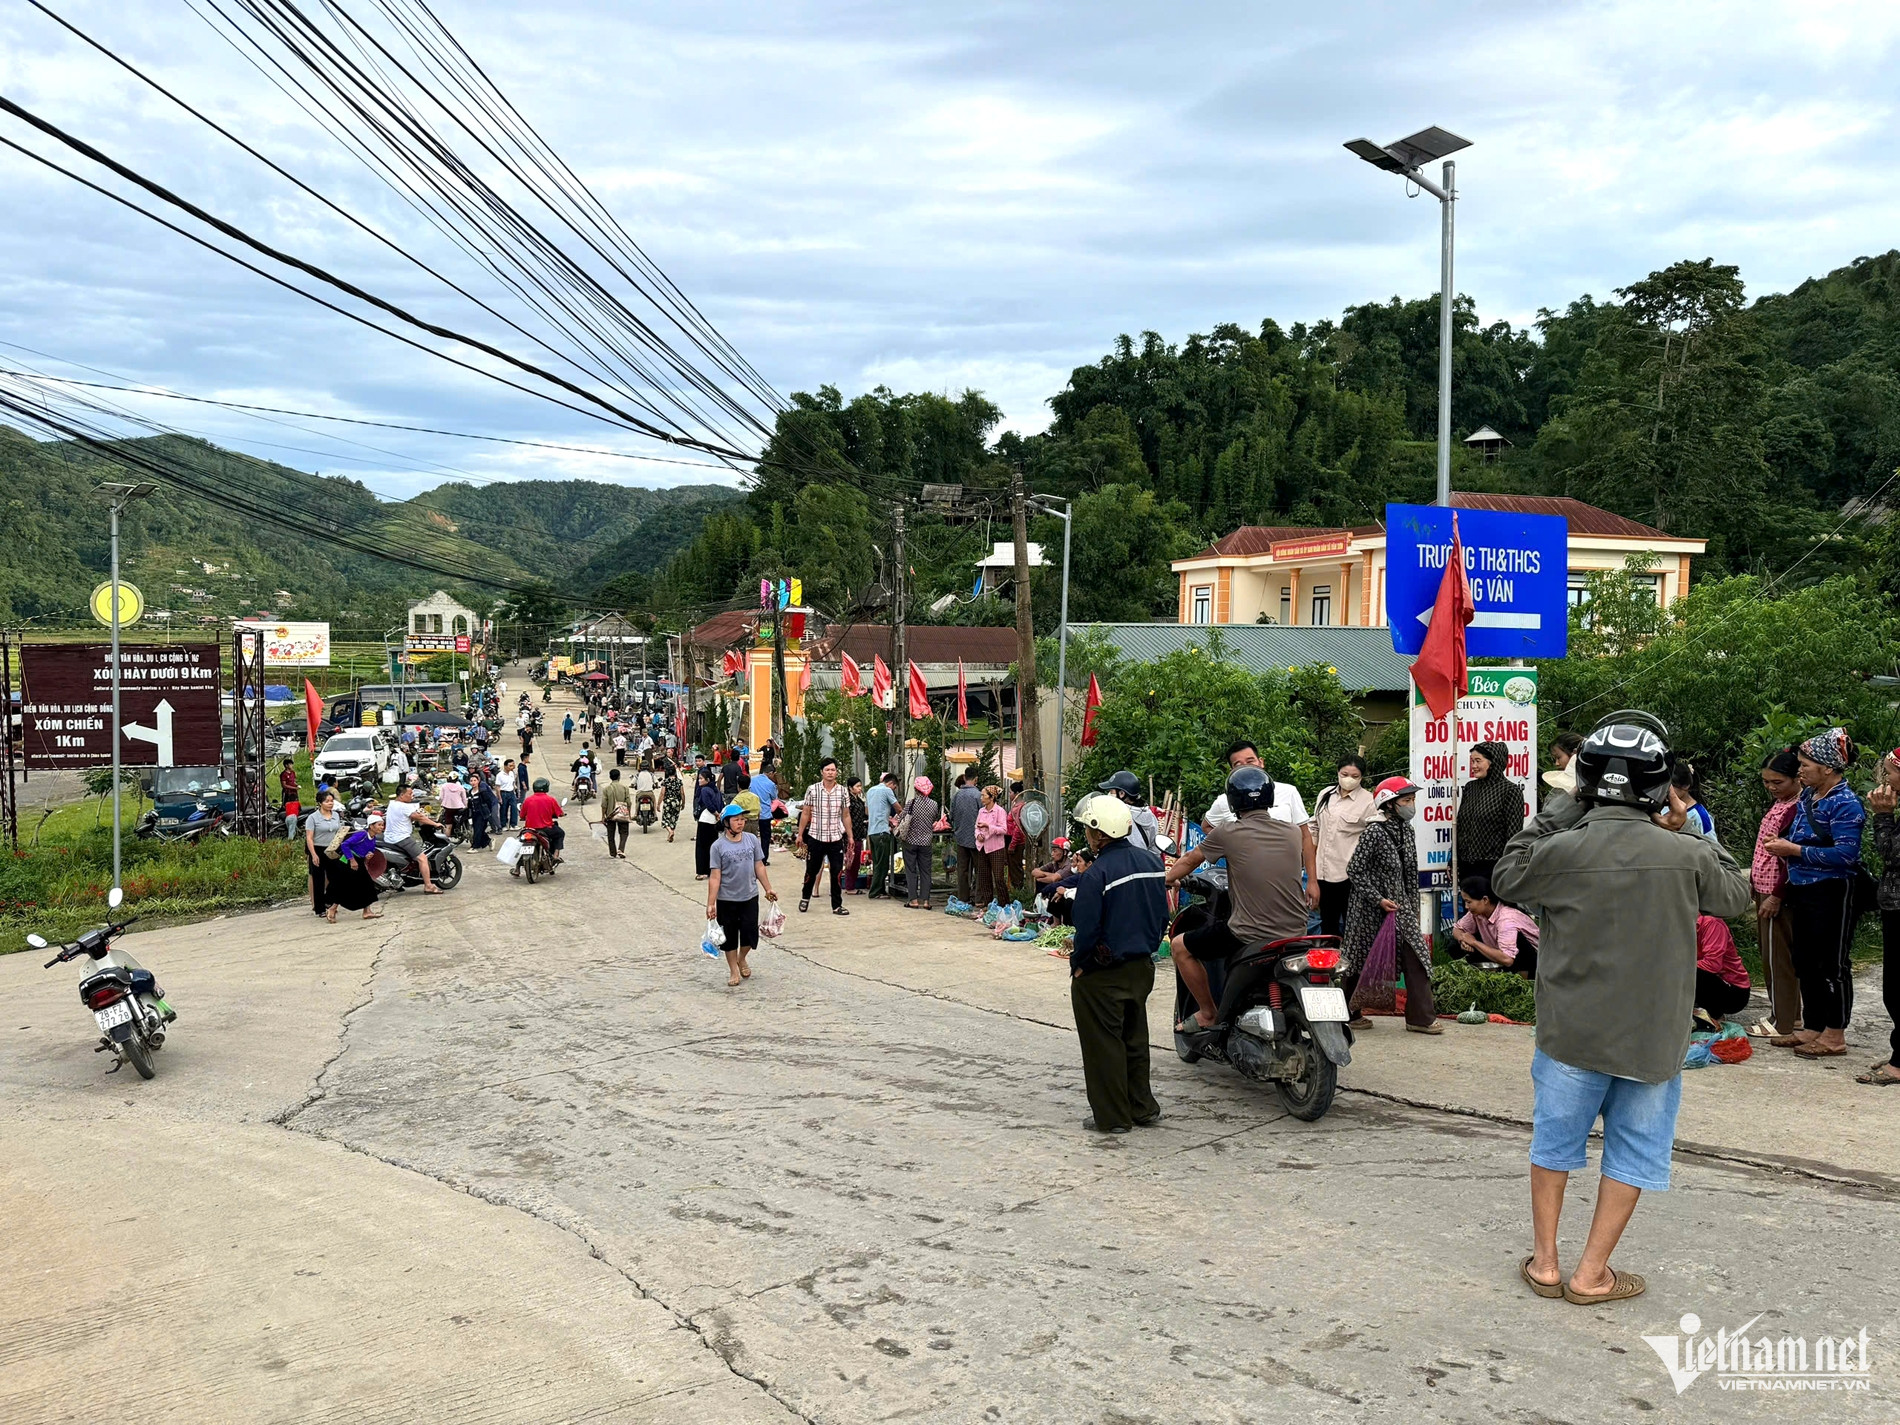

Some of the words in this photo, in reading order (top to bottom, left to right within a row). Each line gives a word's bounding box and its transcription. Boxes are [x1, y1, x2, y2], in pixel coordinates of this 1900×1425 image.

[1479, 547, 1541, 574] TH&THCS
[1487, 574, 1513, 602] VÂN
[123, 666, 148, 680] HÀY
[150, 666, 179, 679] DƯỚI
[1471, 675, 1500, 693] Béo
[35, 717, 63, 730] XÓM
[66, 715, 104, 730] CHIẾN
[1456, 717, 1478, 742] ĂN
[1484, 716, 1529, 742] SÁNG
[1506, 746, 1530, 777] PHỞ
[1428, 783, 1445, 799] LÒNG
